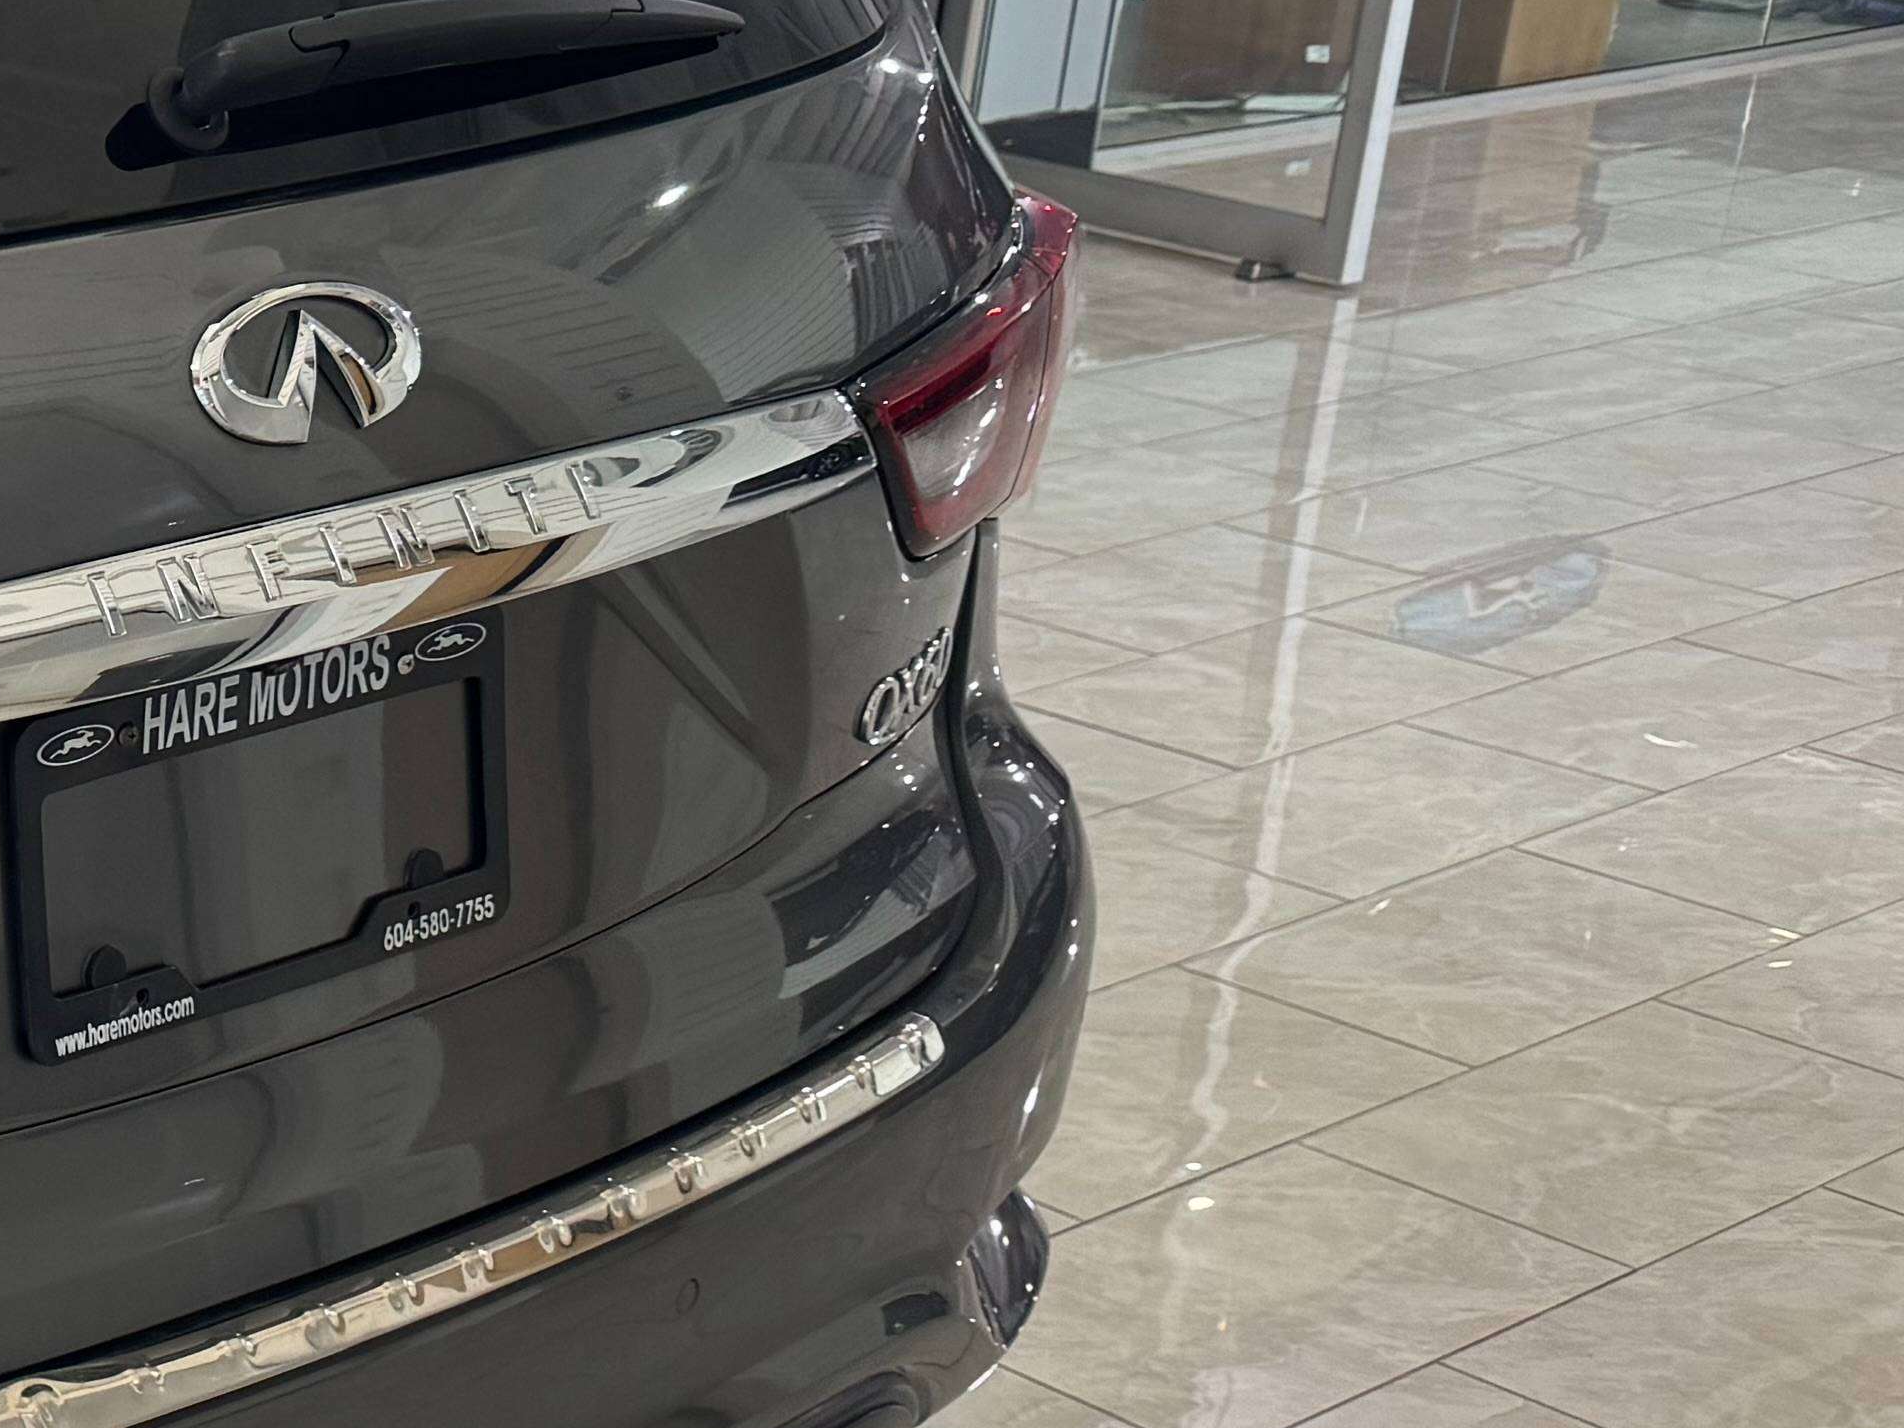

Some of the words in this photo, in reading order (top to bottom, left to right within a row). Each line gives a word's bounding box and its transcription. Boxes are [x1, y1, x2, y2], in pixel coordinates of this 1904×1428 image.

[88, 459, 601, 637] INFINITI
[142, 674, 241, 755] HARE
[248, 634, 392, 726] MOTORS
[856, 627, 953, 745] QX60
[383, 893, 495, 952] 604-580-7755
[55, 995, 196, 1057] www.haremotors.com
